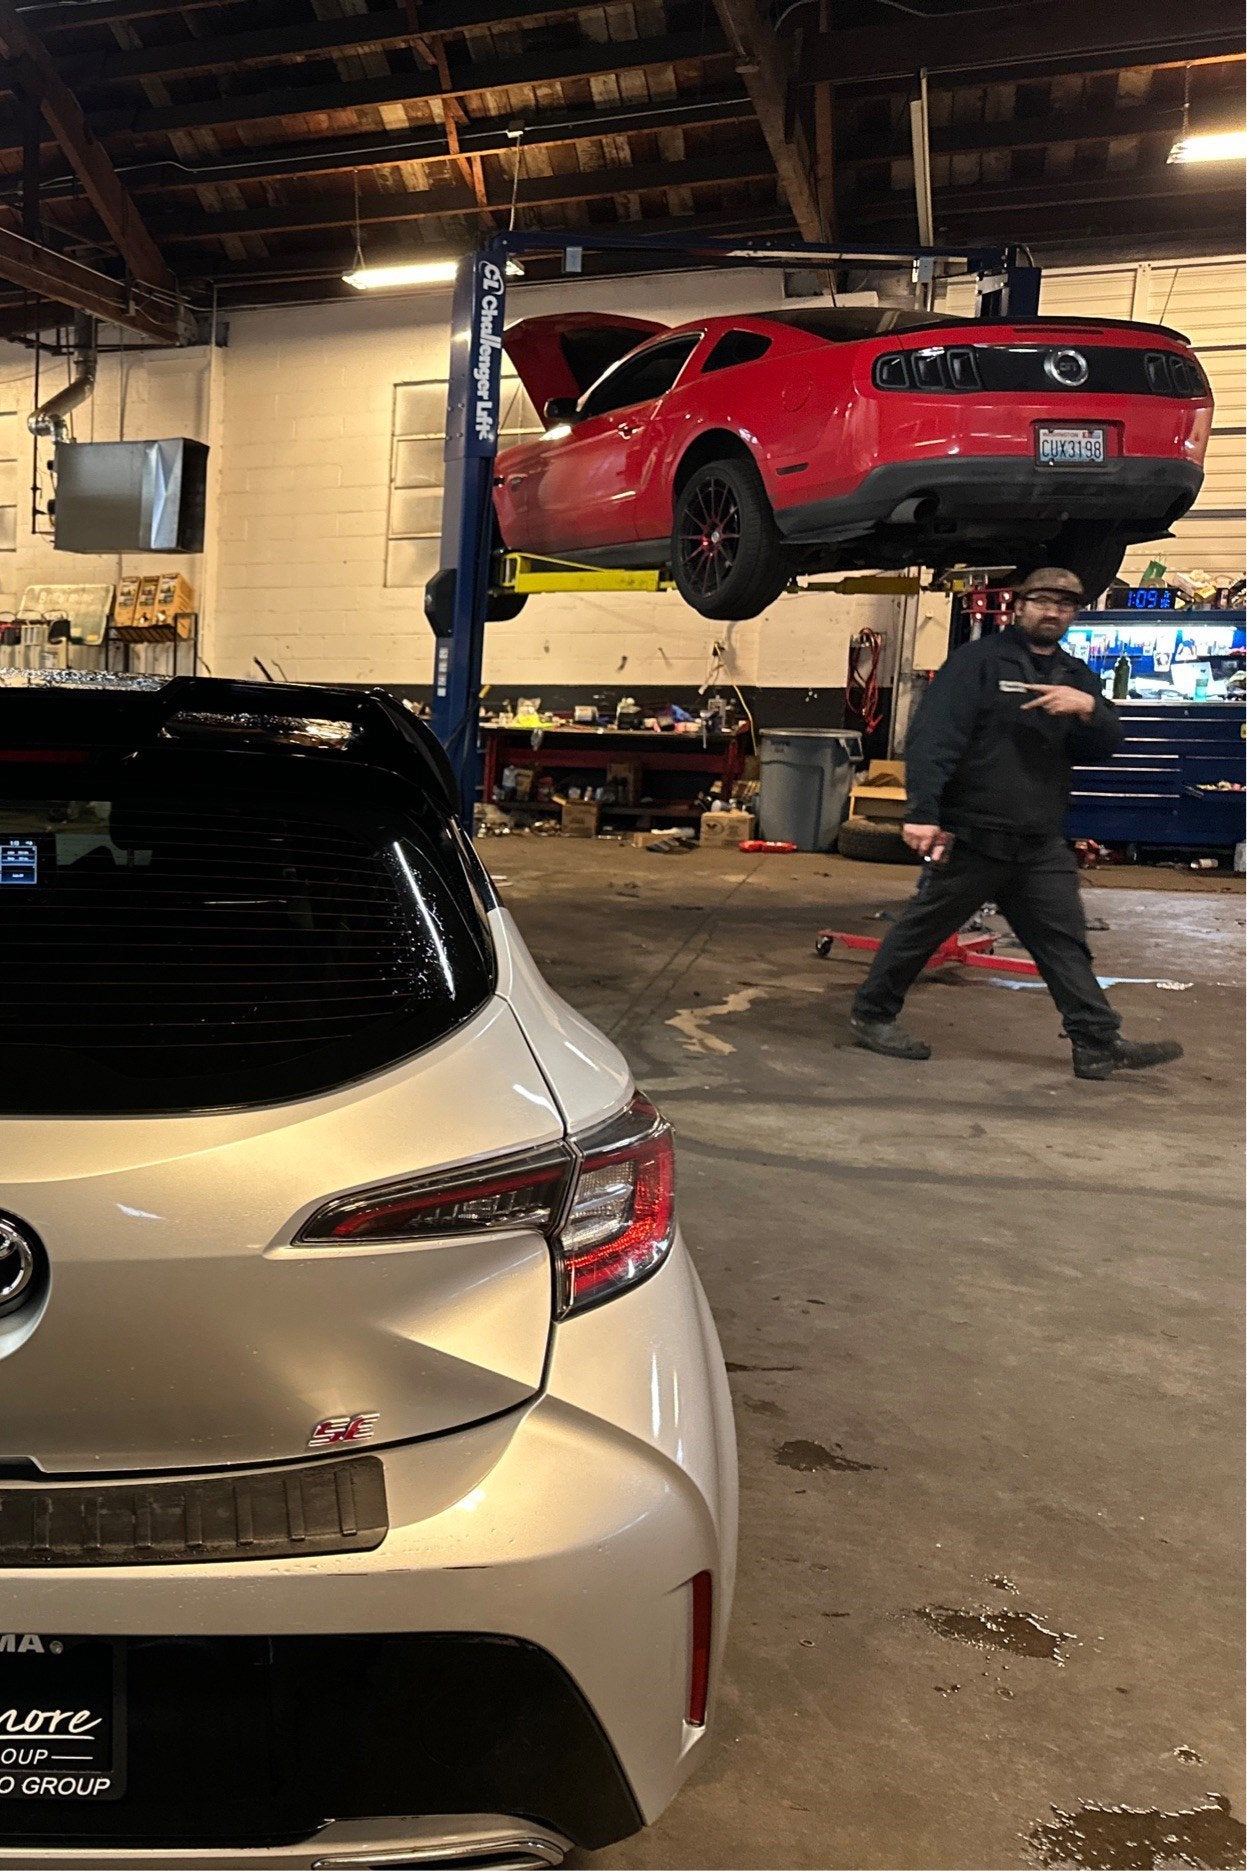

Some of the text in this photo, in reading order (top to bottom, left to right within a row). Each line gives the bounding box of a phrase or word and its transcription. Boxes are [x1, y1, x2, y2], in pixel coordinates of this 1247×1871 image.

[474, 295, 501, 400] Challenger
[1042, 440, 1101, 458] CUX3198
[1128, 590, 1158, 608] 1:09
[308, 1413, 380, 1447] SE
[21, 1777, 111, 1796] GROUP
